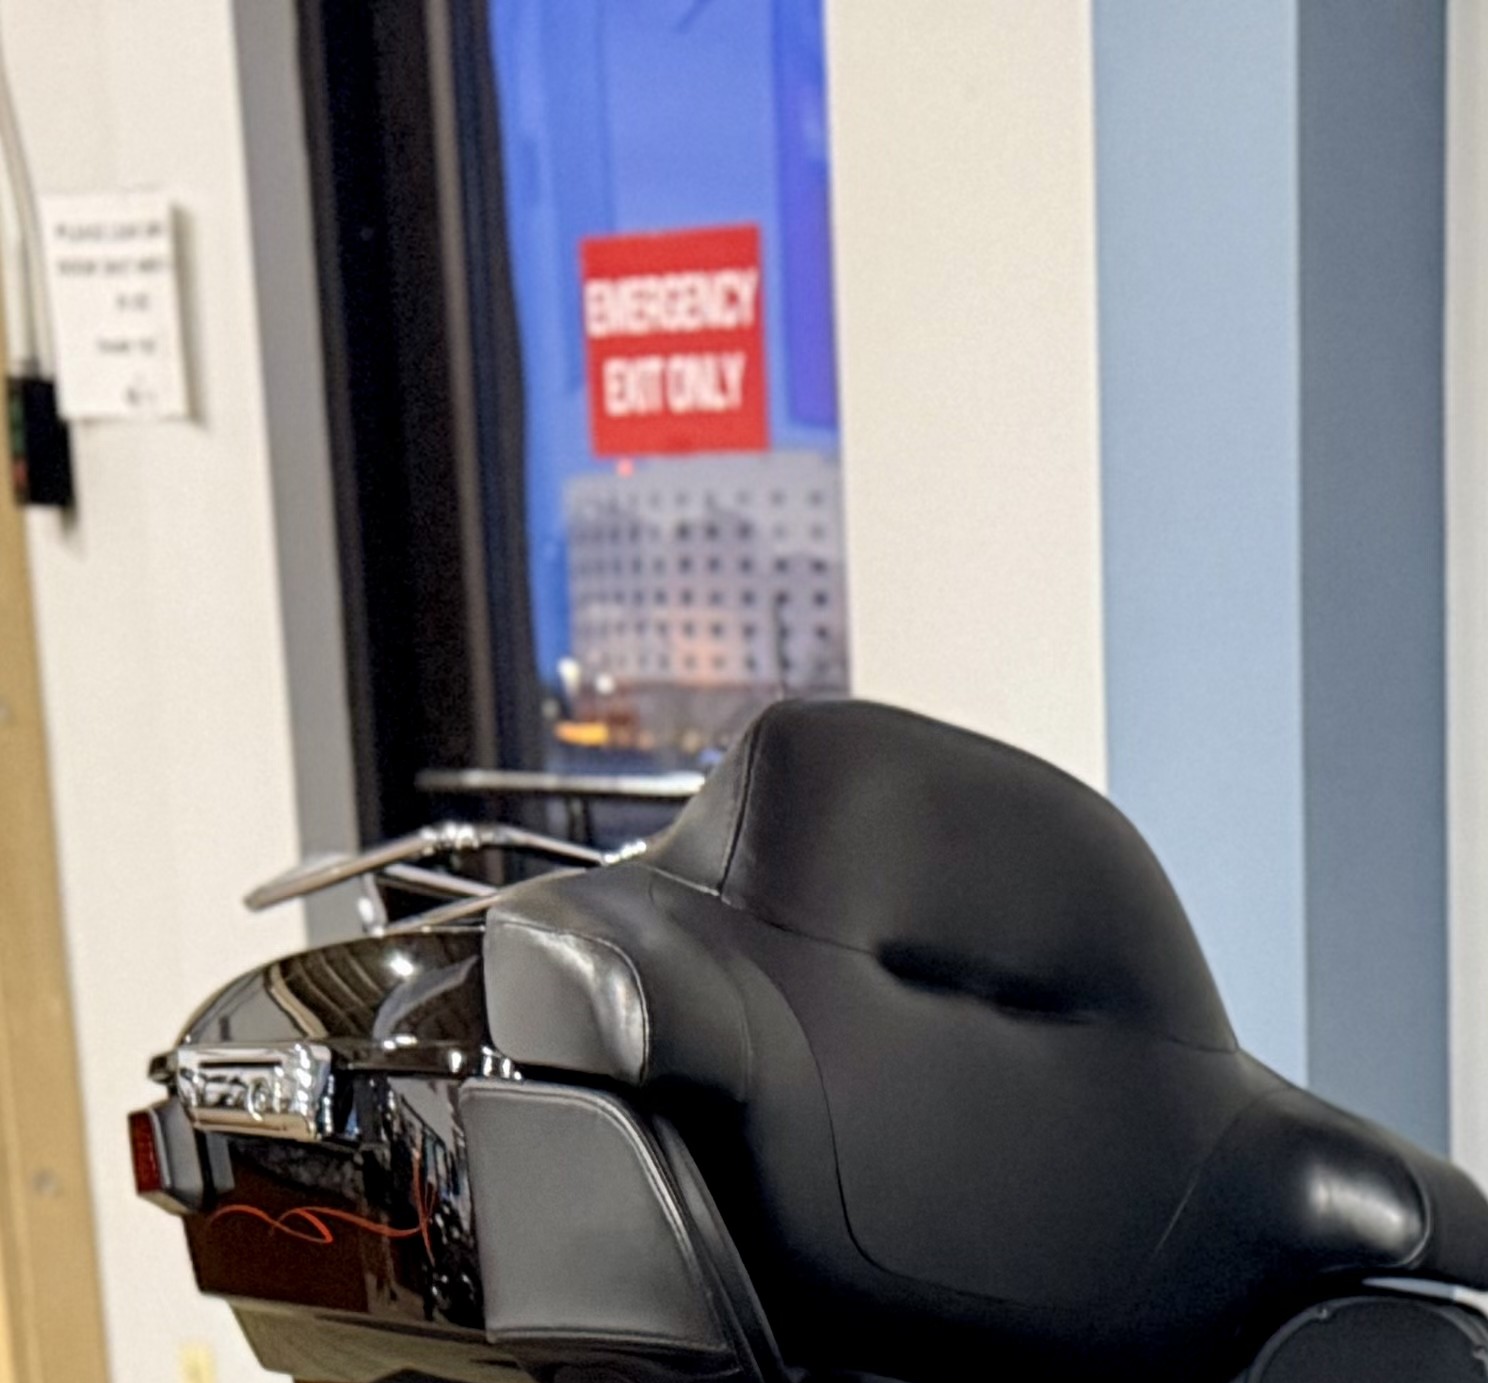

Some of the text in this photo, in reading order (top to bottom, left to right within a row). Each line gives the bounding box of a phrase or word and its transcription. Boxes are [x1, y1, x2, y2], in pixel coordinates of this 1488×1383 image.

[584, 266, 758, 338] EMERGENCY
[603, 350, 747, 418] EXIT ONLY
